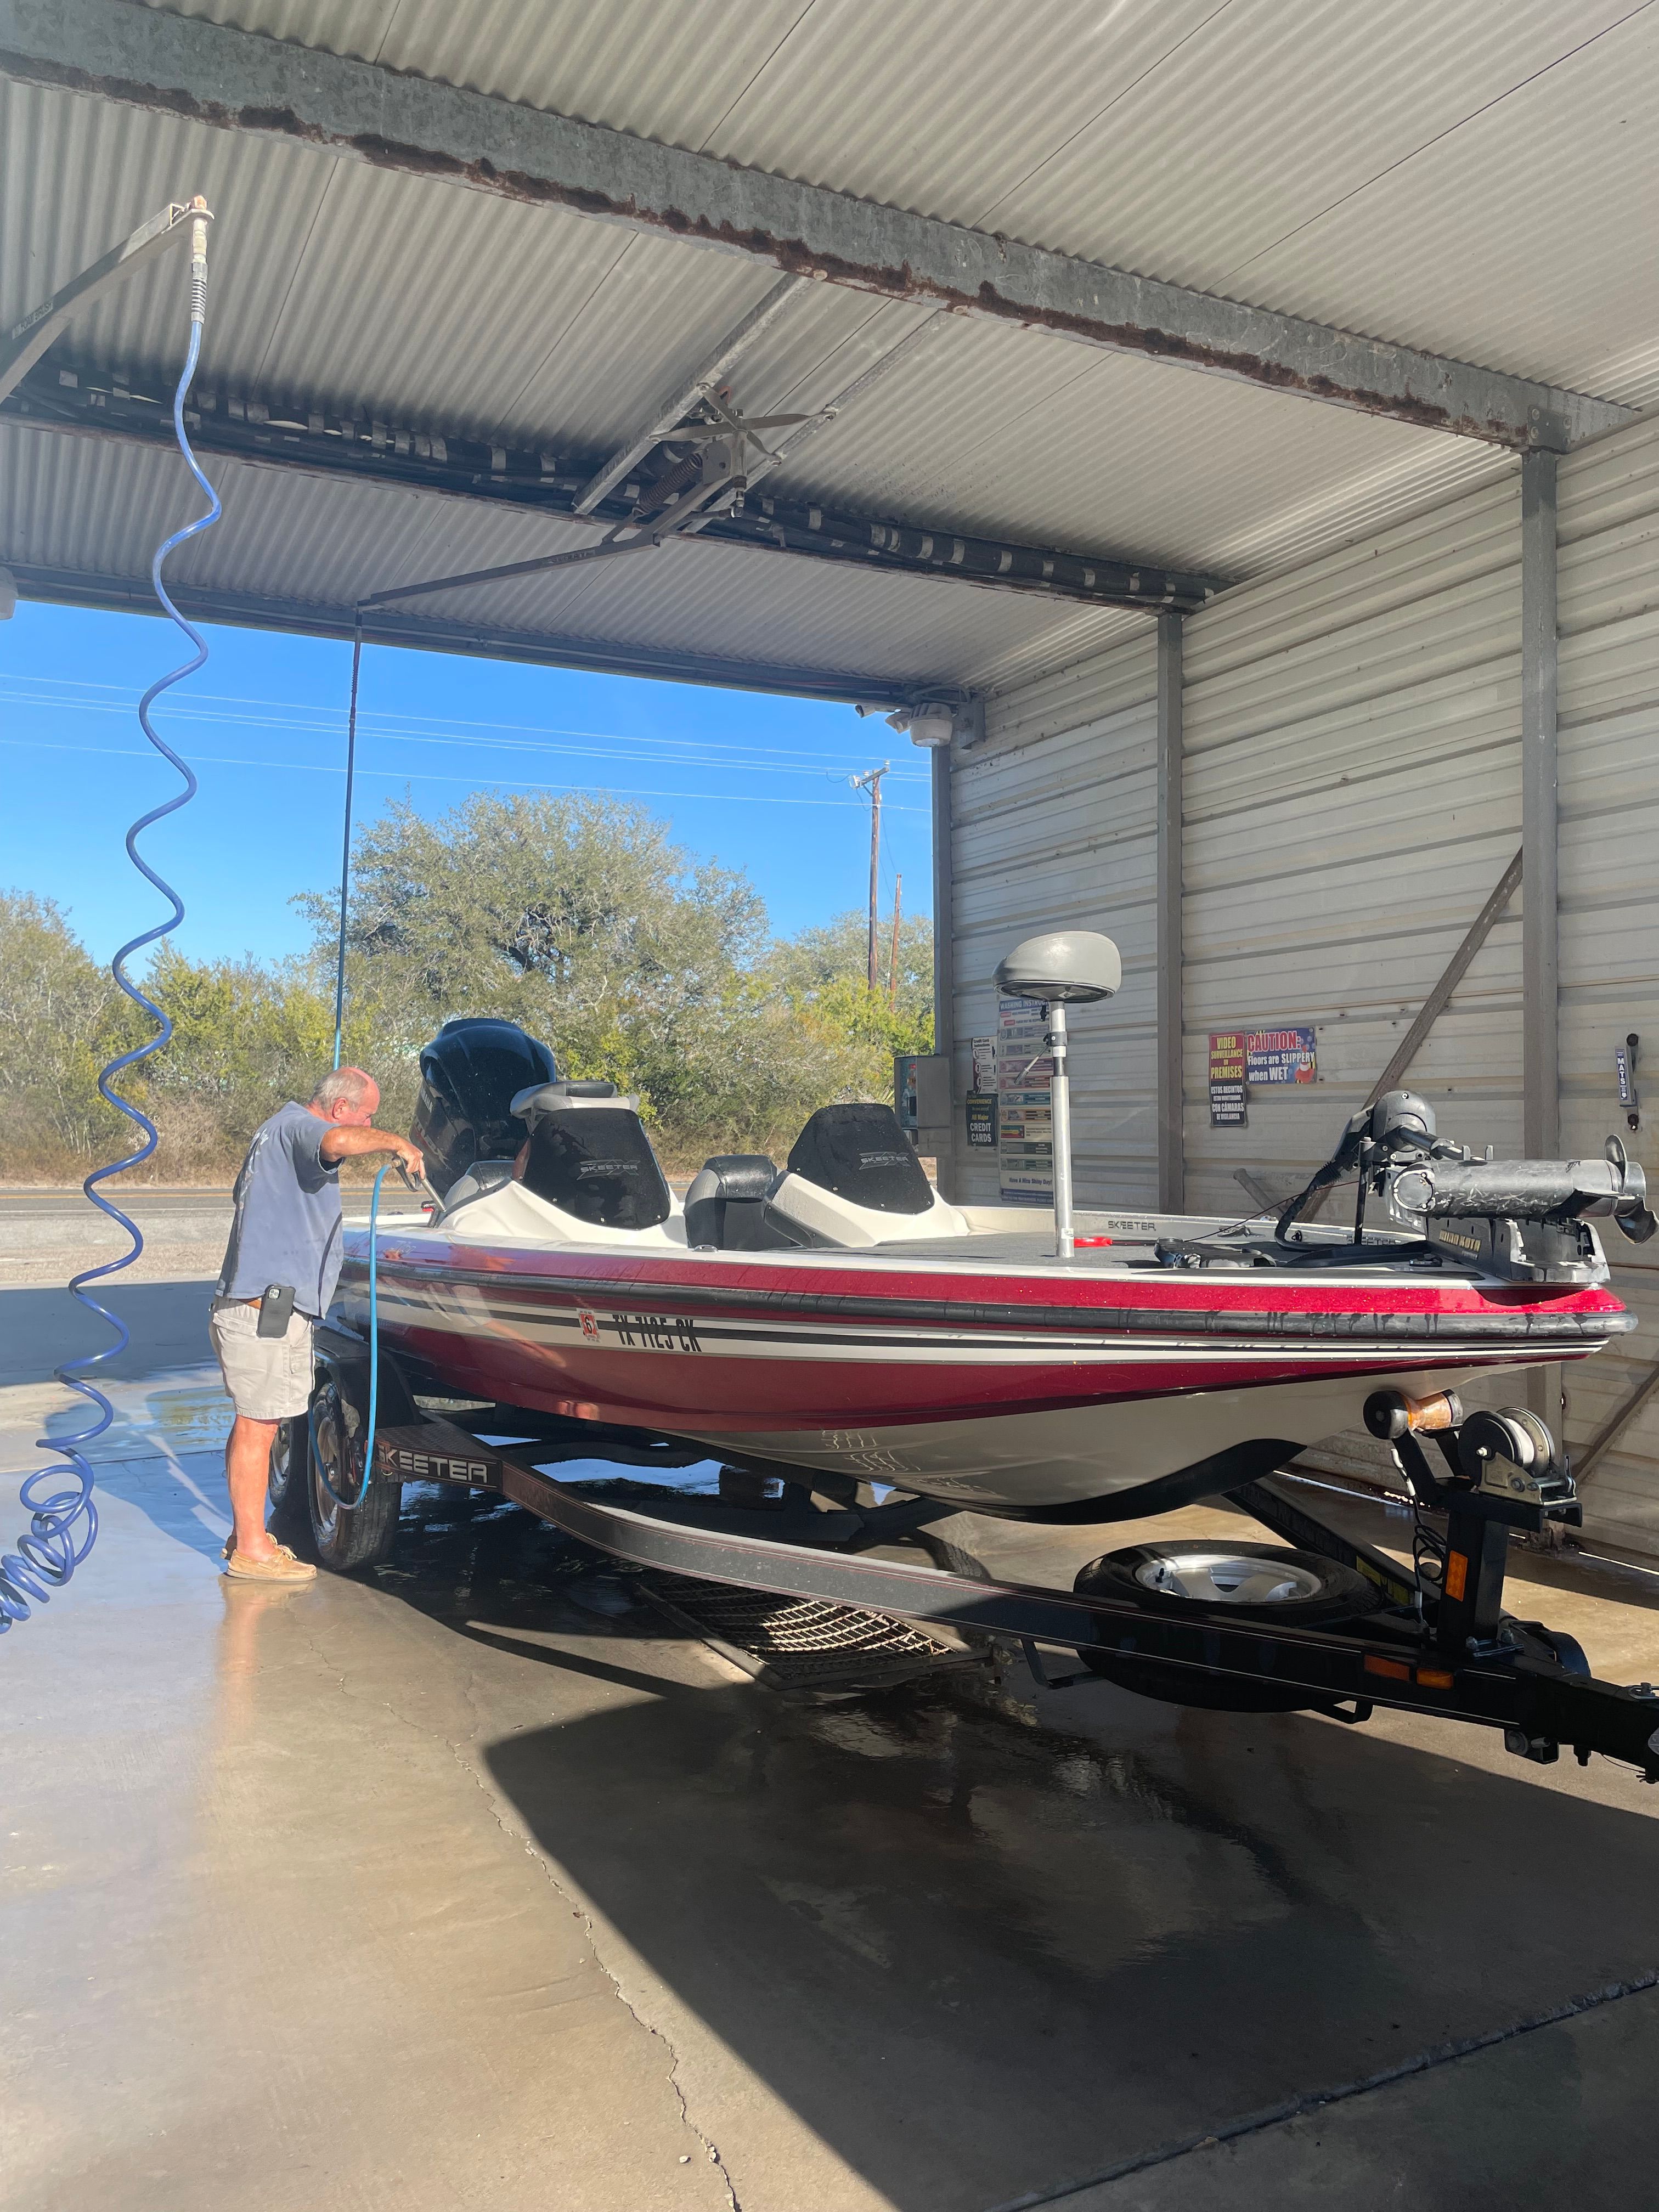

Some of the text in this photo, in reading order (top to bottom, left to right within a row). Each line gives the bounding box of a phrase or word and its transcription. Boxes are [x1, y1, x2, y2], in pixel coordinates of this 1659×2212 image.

[1000, 1001, 1022, 1009] WASHING
[1216, 1036, 1236, 1049] VIDEO
[1247, 1030, 1301, 1052] CAUTION:
[1211, 1049, 1243, 1059] SURVEILLANCE
[1248, 1052, 1314, 1065] Floors are SLIPPERY
[1211, 1065, 1242, 1079] PREMISES
[1249, 1066, 1288, 1081] when WET
[1617, 1058, 1626, 1085] MATS
[1223, 1085, 1243, 1094] RECINTOS
[1212, 1102, 1244, 1113] CON CÁMARAS
[970, 1123, 991, 1131] CREDIT
[971, 1133, 992, 1142] CARDS
[580, 1164, 637, 1172] SKEETER
[1108, 1220, 1155, 1231] SKEETER
[612, 1314, 702, 1352] TX 7125 CK
[378, 1444, 487, 1483] SKEETER
